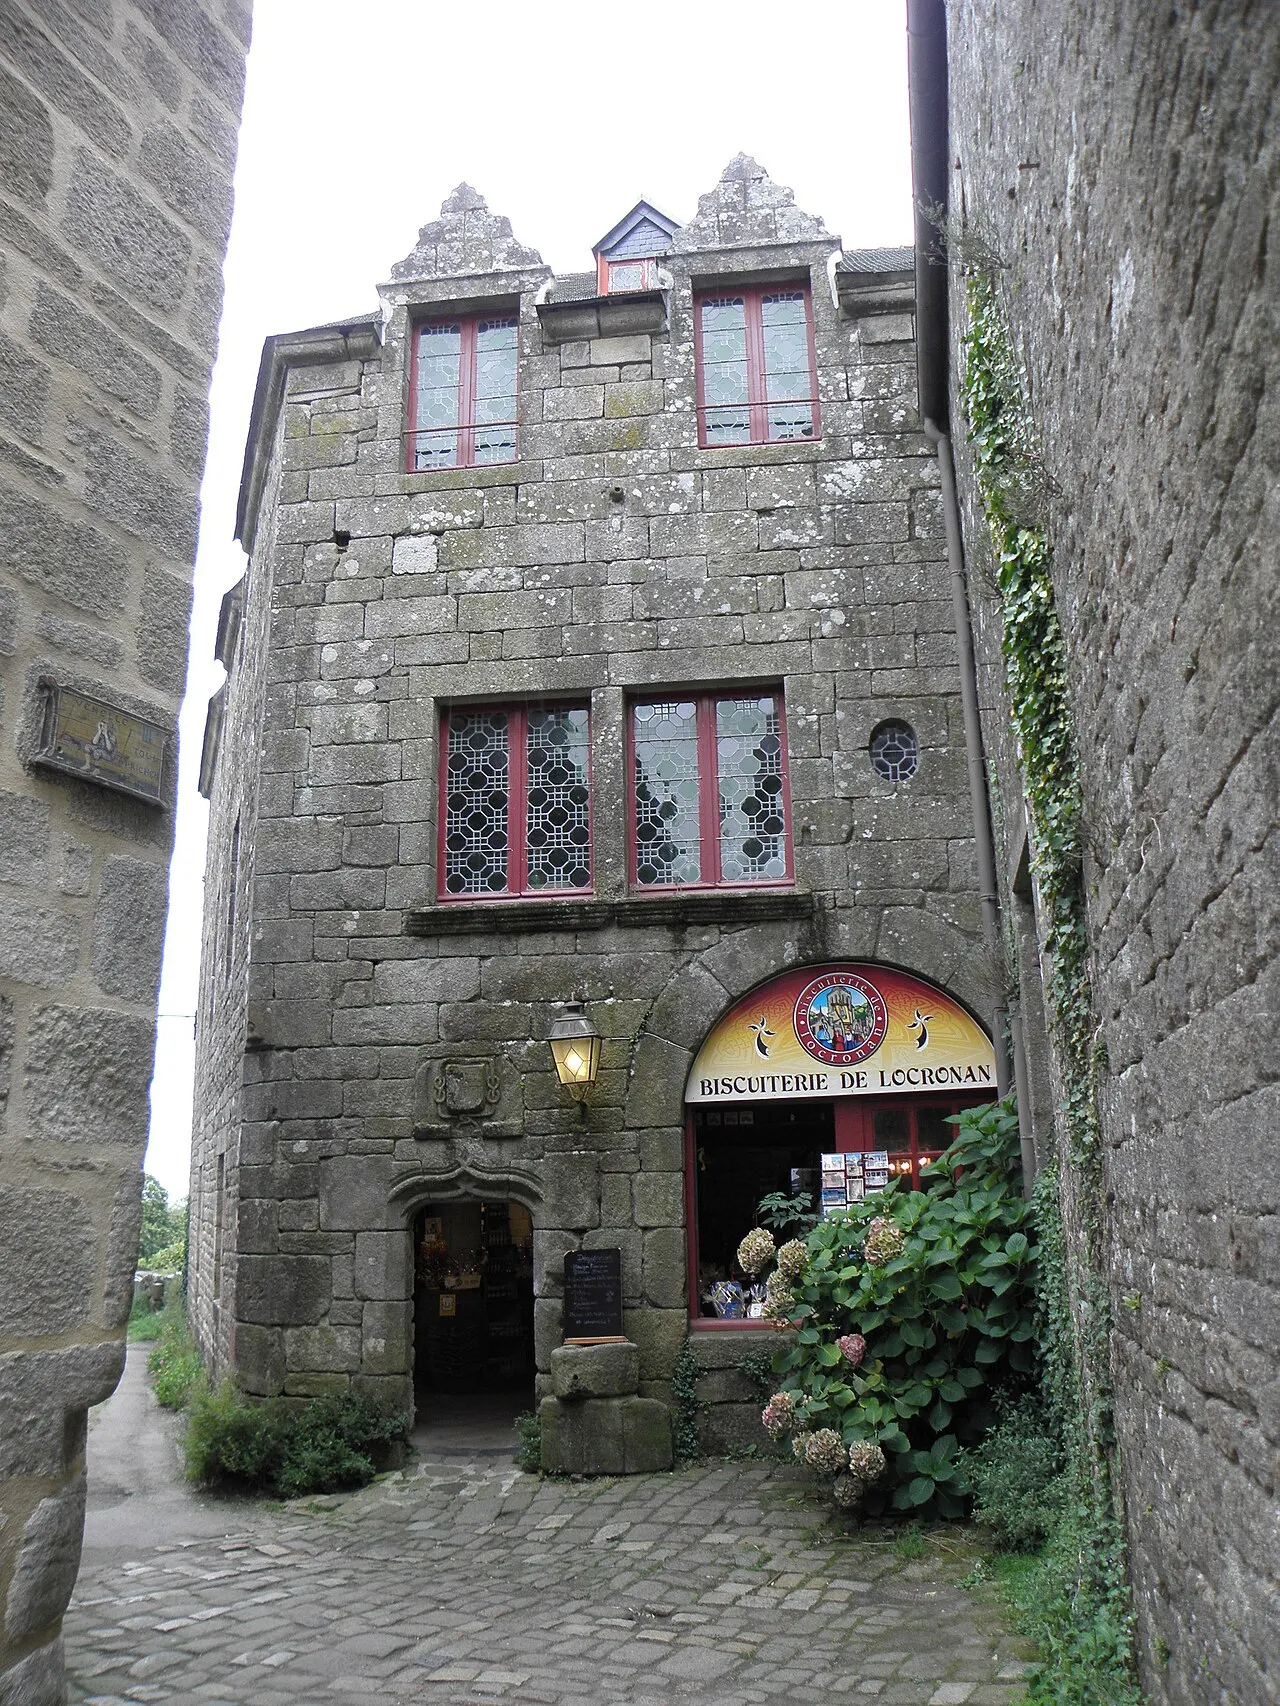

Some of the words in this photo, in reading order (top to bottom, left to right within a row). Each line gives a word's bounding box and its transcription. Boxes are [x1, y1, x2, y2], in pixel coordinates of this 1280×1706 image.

[798, 976, 868, 1015] biscuiterie
[870, 996, 881, 1011] de
[800, 1028, 883, 1063] locronan
[700, 1073, 828, 1096] BISCUITERIE
[840, 1071, 868, 1089] DE
[879, 1064, 990, 1087] LOCRONAN
